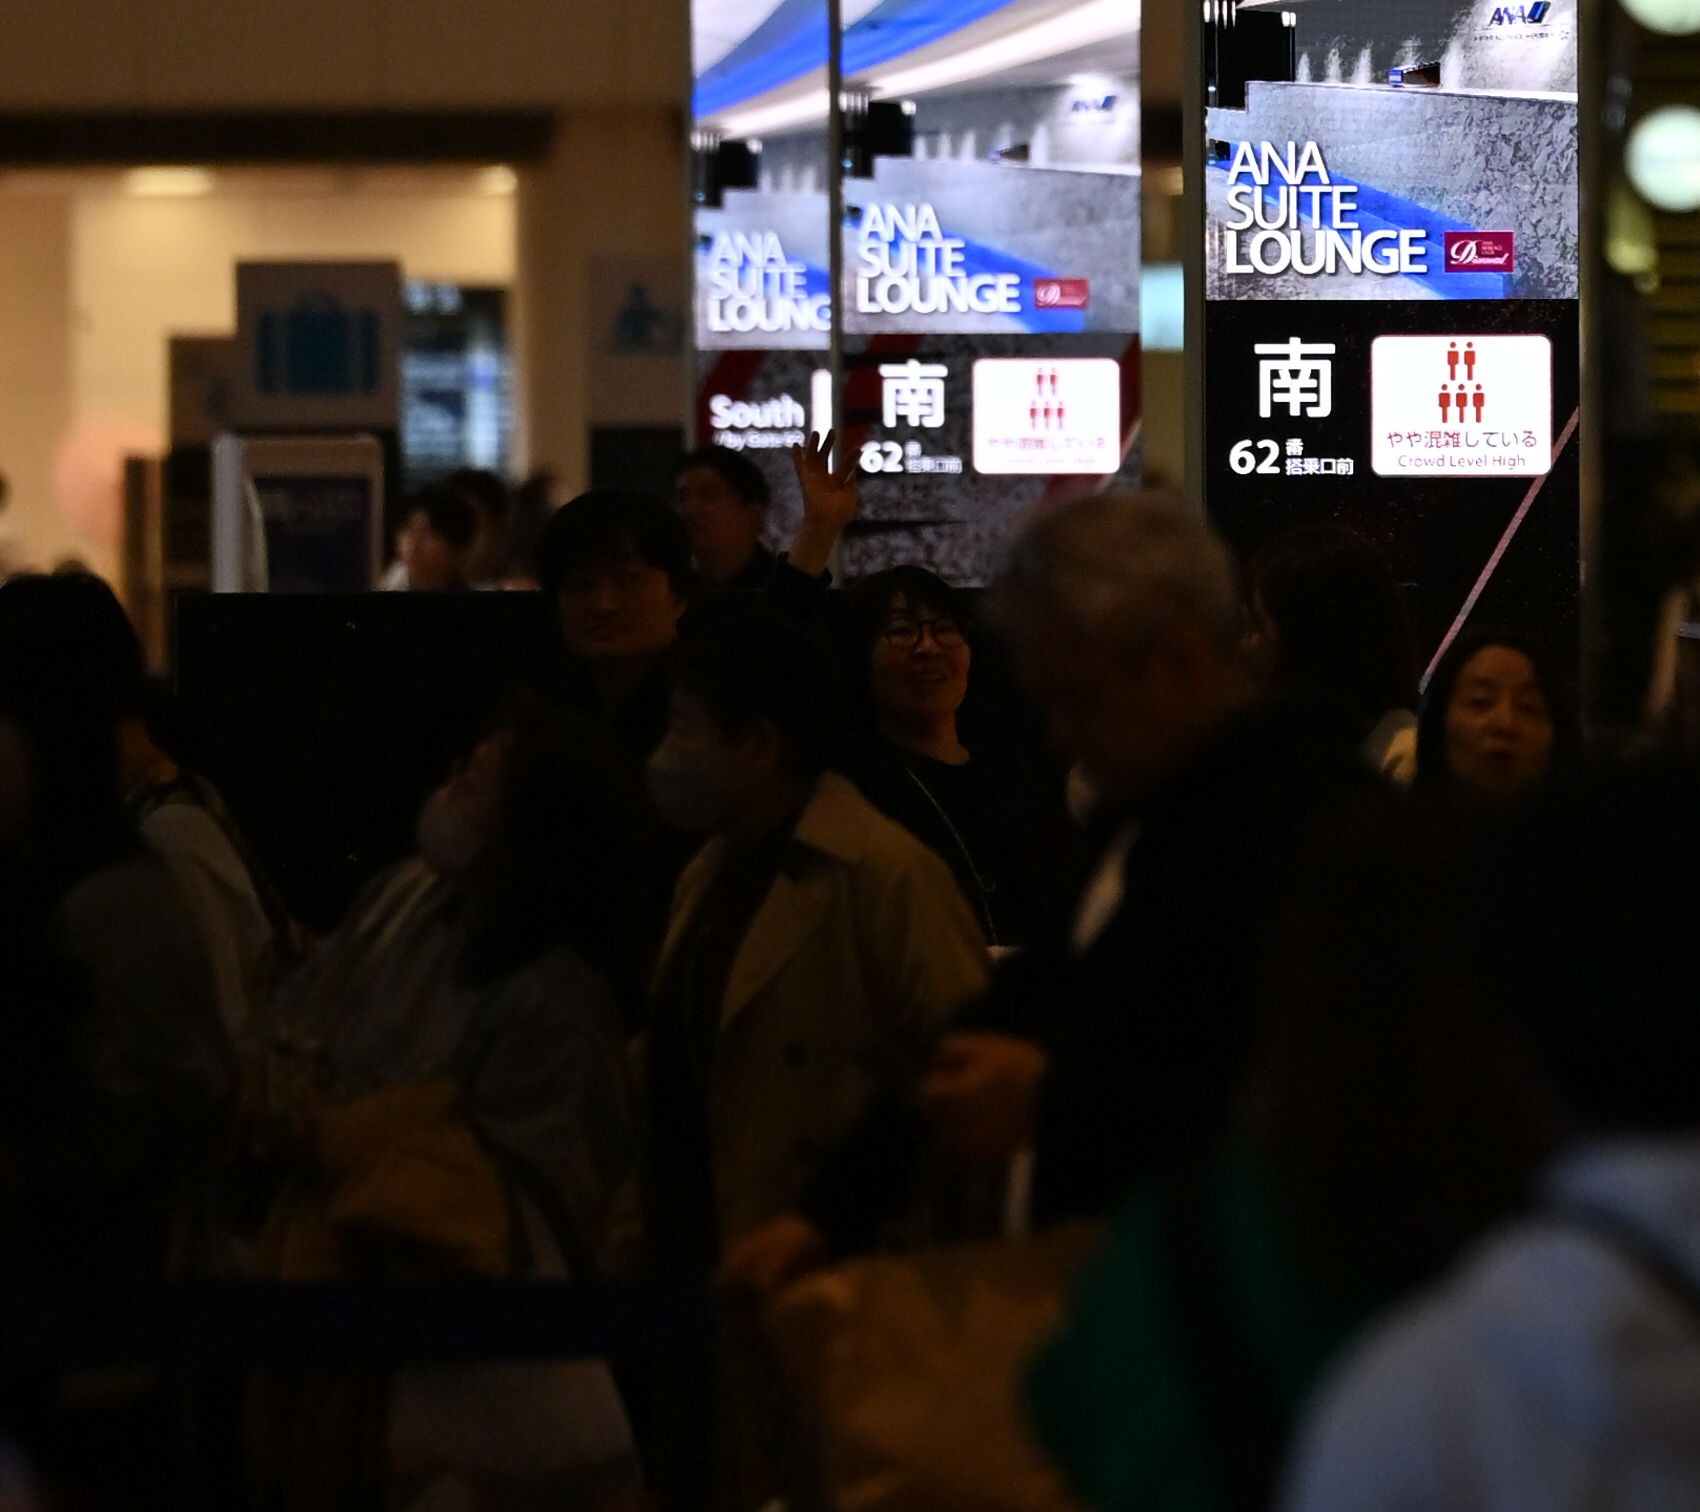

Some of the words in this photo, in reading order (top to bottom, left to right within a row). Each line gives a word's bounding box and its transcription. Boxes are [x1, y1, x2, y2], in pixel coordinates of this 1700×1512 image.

[1227, 141, 1331, 185] ANA
[858, 202, 944, 242] ANA
[1226, 185, 1359, 230] SUITE
[710, 230, 788, 267] ANA
[857, 238, 967, 278] SUITE
[1226, 229, 1428, 275] LOUNGE
[709, 261, 808, 300] SUITE
[857, 273, 1022, 314] LOUNGE
[878, 359, 949, 428] 南
[1254, 336, 1336, 418] 南
[709, 392, 805, 429] South
[859, 440, 904, 474] 62
[1229, 439, 1281, 475] 62
[1386, 430, 1538, 449] やや混雑している
[1397, 454, 1446, 468] Crowd
[1449, 454, 1488, 468] Level
[1492, 454, 1527, 471] High
